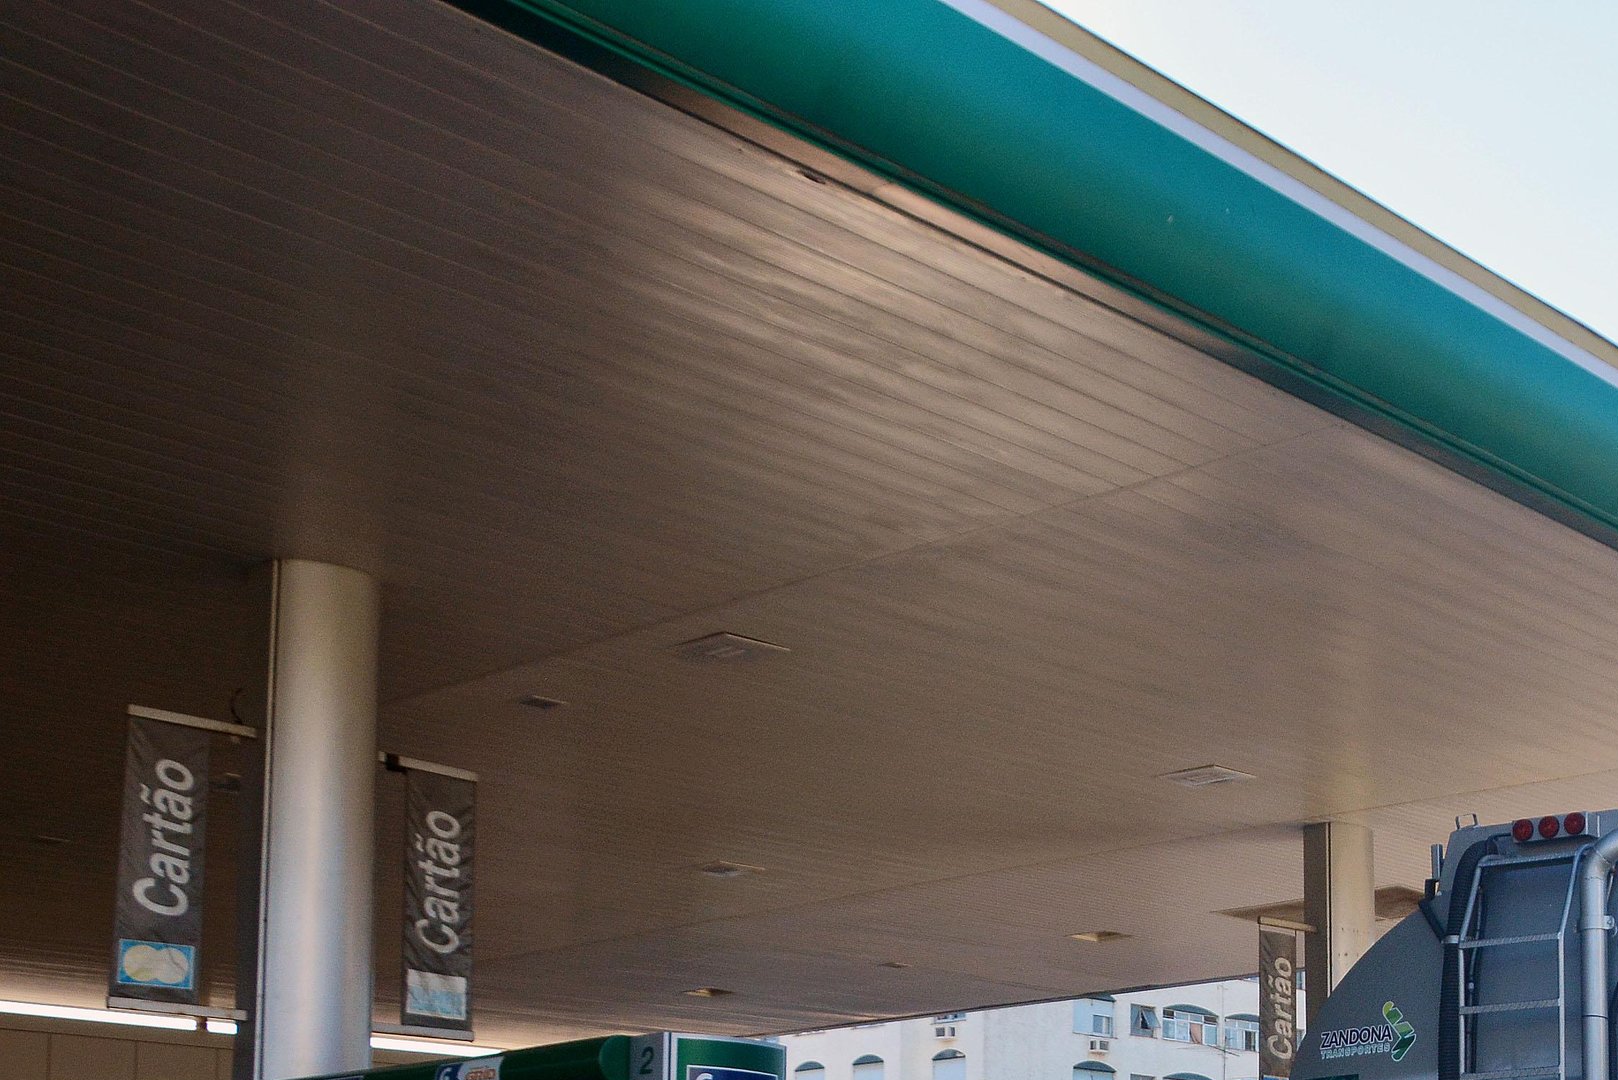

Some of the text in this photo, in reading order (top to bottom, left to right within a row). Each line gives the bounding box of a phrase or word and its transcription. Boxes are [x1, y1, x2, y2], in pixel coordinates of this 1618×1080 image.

[132, 758, 195, 917] Cartão
[414, 809, 462, 955] Cartão
[1267, 955, 1294, 1061] Cartão
[1320, 1024, 1393, 1050] ZANDONA
[639, 1046, 654, 1075] 2
[1320, 1042, 1391, 1060] TRANSPORTES
